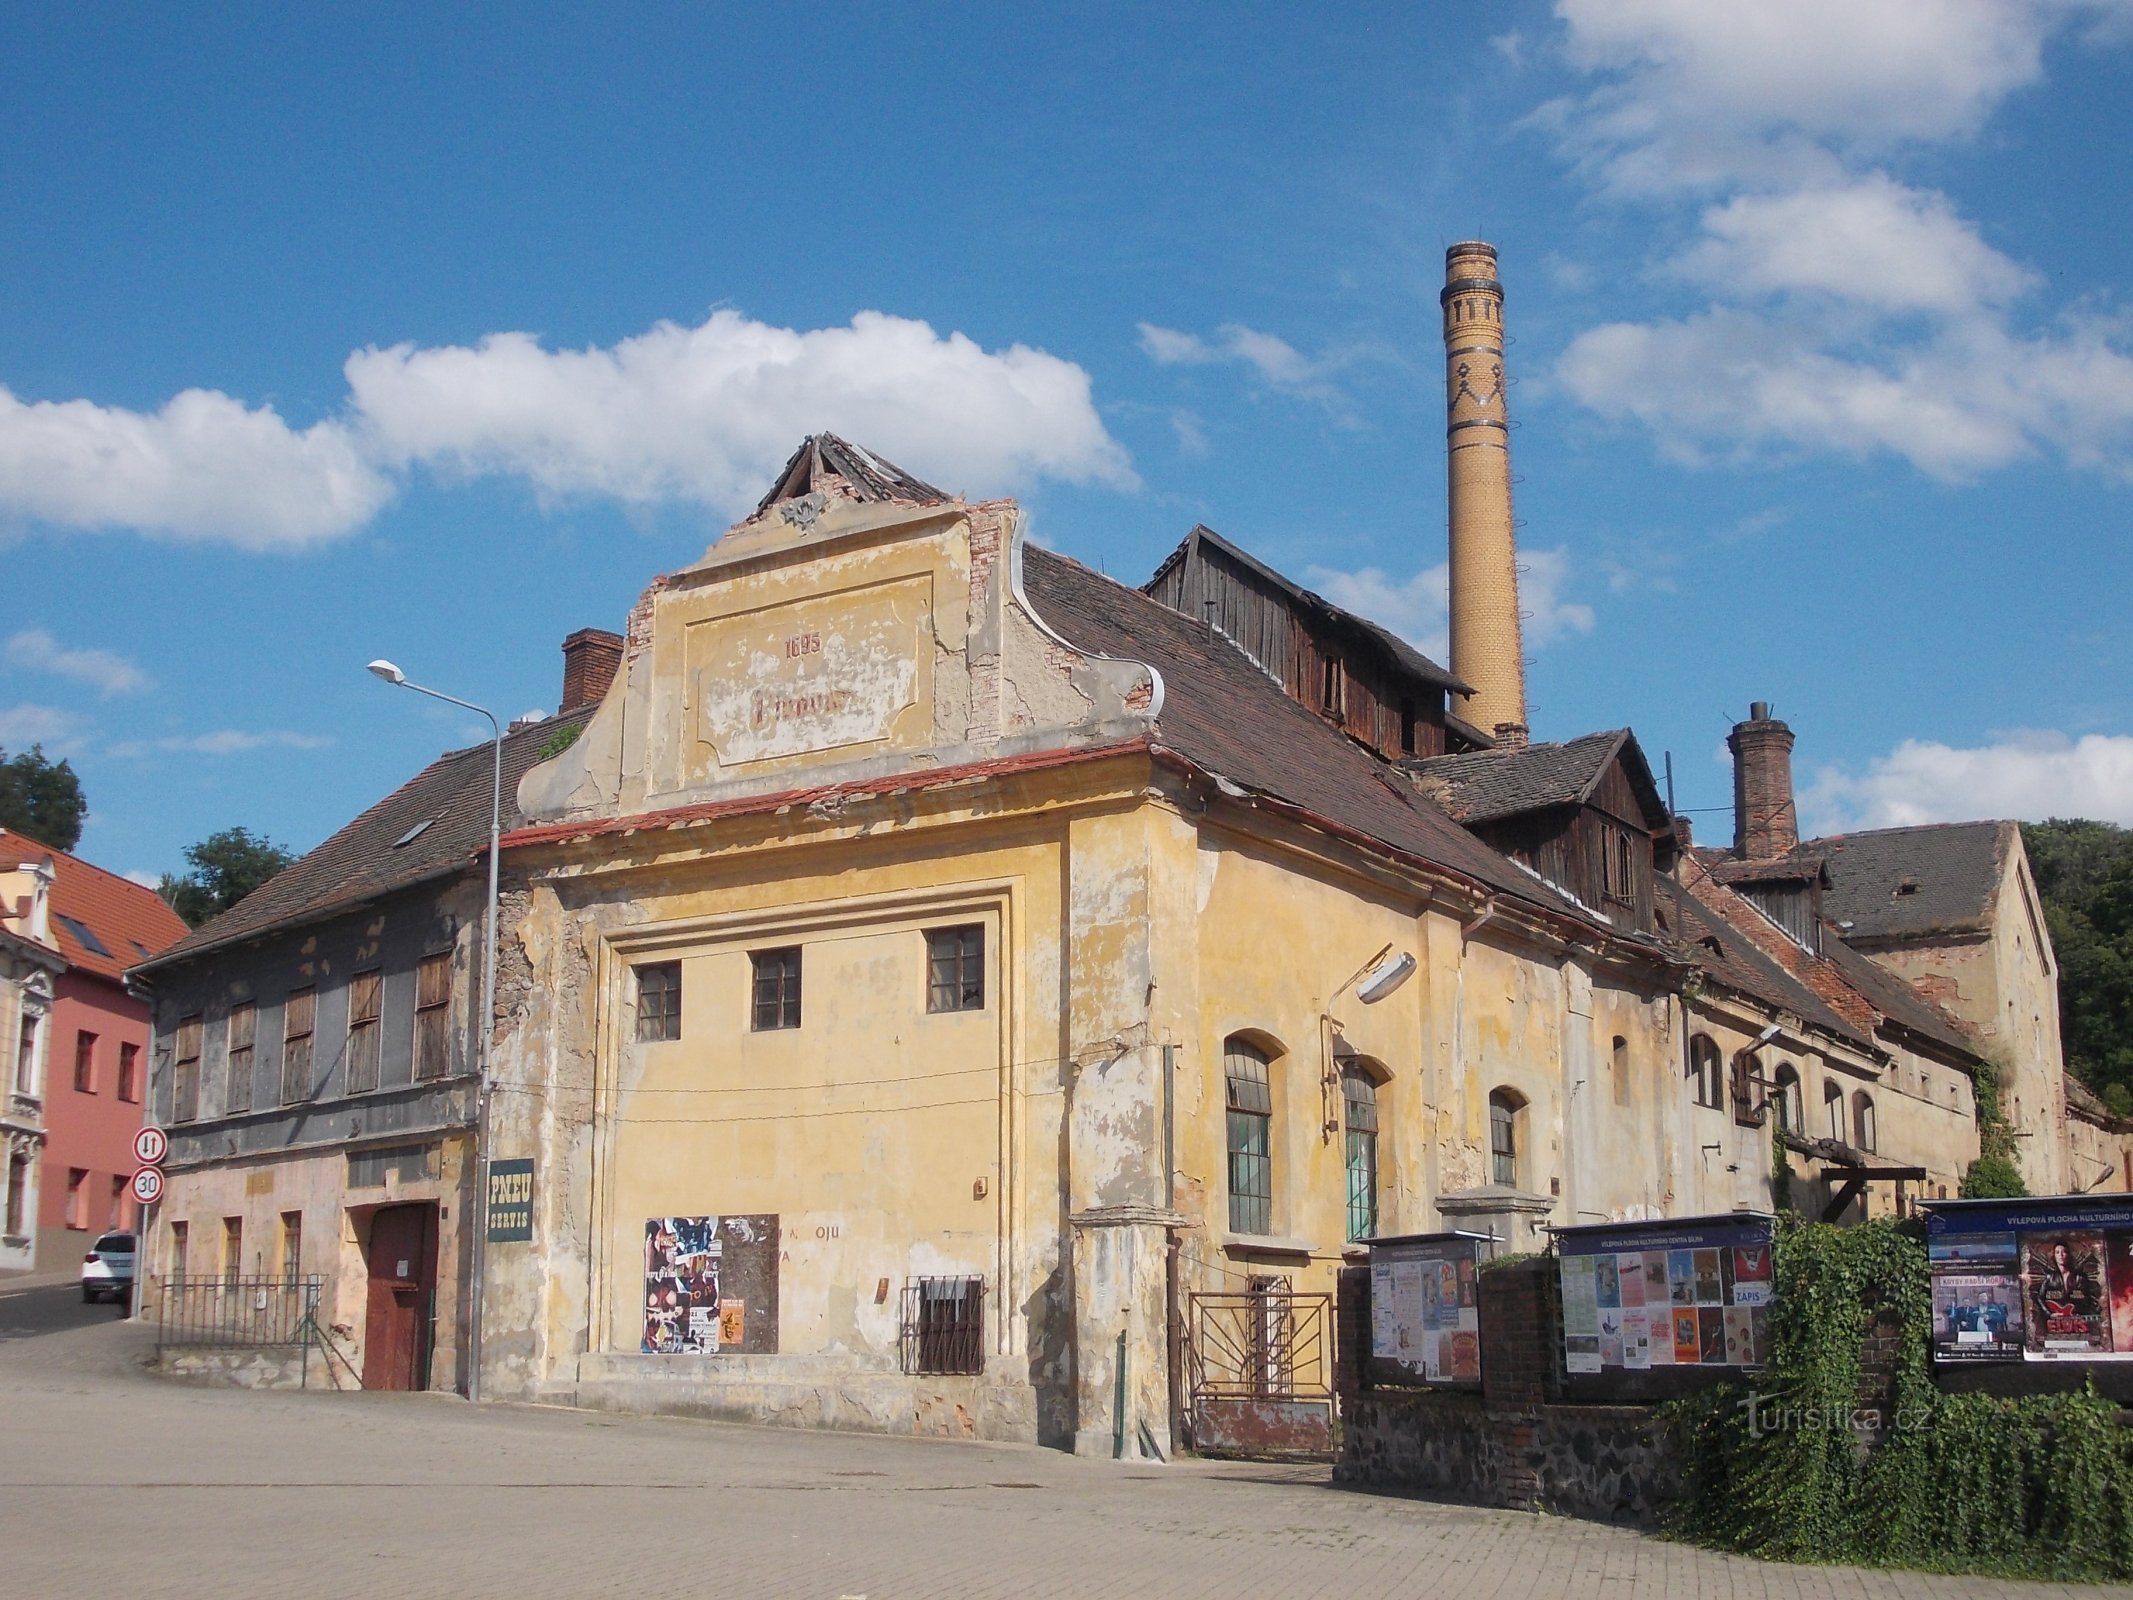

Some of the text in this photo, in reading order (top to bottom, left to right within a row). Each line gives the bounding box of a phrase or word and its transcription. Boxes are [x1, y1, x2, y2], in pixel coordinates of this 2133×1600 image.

[785, 632, 820, 659] 1695
[138, 1176, 157, 1193] 30
[491, 1173, 532, 1204] PNEU
[490, 1212, 528, 1229] SERVIS
[2048, 1214, 2079, 1224] PLOCHA
[2080, 1212, 2130, 1223] KULTURNÍHO
[2046, 1319, 2089, 1334] ELVIS
